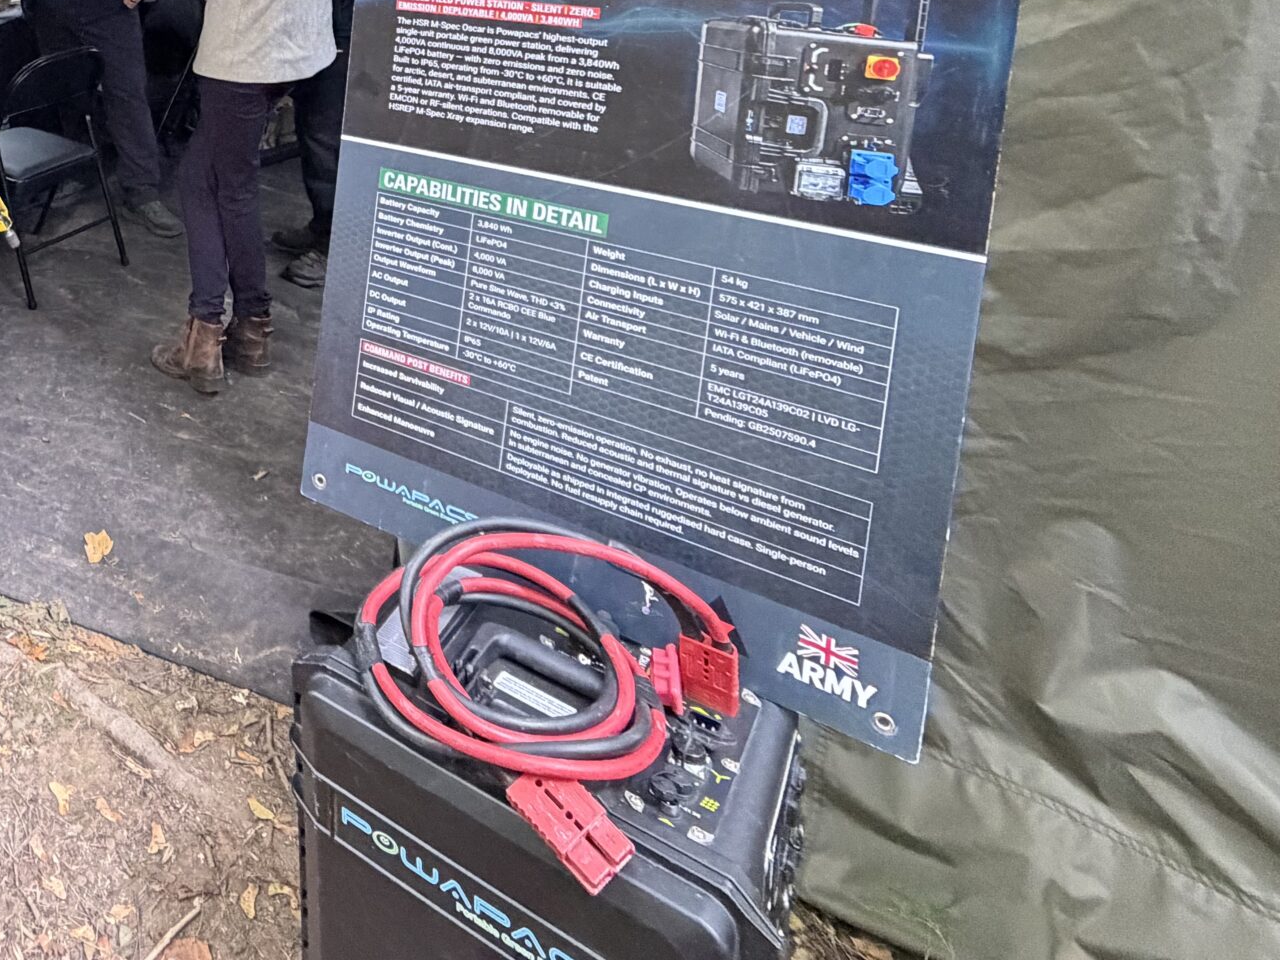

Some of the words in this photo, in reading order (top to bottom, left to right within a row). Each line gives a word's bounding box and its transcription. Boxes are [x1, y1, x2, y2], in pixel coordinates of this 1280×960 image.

[397, 0, 437, 13] EMISSION
[442, 5, 494, 18] DEPLOYABLE
[499, 10, 533, 23] 4,000VA
[539, 14, 580, 27] 3,840WH
[530, 2, 563, 14] SILENT
[568, 5, 597, 18] ZERO-
[395, 26, 435, 37] single-unit
[434, 31, 469, 41] portable
[468, 35, 493, 44] green
[493, 37, 520, 47] power
[521, 40, 553, 52] station,
[554, 43, 599, 58] delivering
[396, 15, 412, 25] The
[411, 17, 430, 27] HSR
[429, 19, 461, 31] M-Spec
[461, 22, 486, 33] Oscar
[486, 25, 494, 34] is
[541, 31, 608, 47] highest-output
[394, 35, 426, 46] 4,000VA
[426, 40, 470, 52] continuous
[470, 45, 487, 54] and
[487, 46, 523, 58] 8,000VA
[523, 51, 546, 61] peak
[546, 52, 569, 64] from
[569, 57, 577, 65] a
[577, 56, 620, 70] 3,840Wh
[390, 74, 423, 86] certified,
[424, 77, 443, 88] IATA
[442, 81, 492, 95] air-transport
[492, 89, 537, 103] compliant,
[537, 95, 556, 105] and
[556, 98, 593, 110] covered
[593, 102, 606, 114] by
[391, 63, 403, 72] for
[403, 66, 427, 77] arctic,
[427, 68, 455, 81] desert,
[455, 73, 472, 82] and
[472, 75, 527, 90] subterranean
[527, 83, 590, 99] environments.
[591, 91, 606, 101] CE
[387, 101, 415, 113] HSREP
[415, 106, 445, 118] M-Spec
[445, 110, 464, 123] Xray
[464, 115, 507, 128] expansion
[507, 122, 534, 134] range.
[388, 92, 419, 104] EMCON
[428, 98, 463, 112] RF-silent
[463, 105, 509, 119] operations.
[510, 111, 561, 127] Compatible
[561, 120, 581, 130] with
[582, 122, 598, 133] the
[383, 170, 502, 211] CAPABILITIES
[505, 196, 528, 217] IN
[531, 201, 602, 234] DETAIL
[592, 245, 626, 261] Weight
[587, 279, 631, 299] Charging
[632, 289, 664, 305] Inputs
[720, 273, 734, 284] 54
[735, 276, 748, 289] kg
[584, 309, 599, 321] Air
[600, 313, 647, 334] Transport
[586, 294, 646, 319] Connectivity
[582, 328, 625, 349] Warranty
[713, 327, 739, 341] Wi-Fi
[740, 334, 749, 344] &
[749, 336, 799, 357] Bluetooth
[799, 349, 863, 375] (removable)
[579, 350, 594, 362] CE
[594, 355, 653, 380] Certification
[709, 362, 717, 373] 5
[717, 366, 745, 380] years
[711, 343, 735, 357] IATA
[735, 349, 788, 371] Compliant
[577, 369, 609, 387] Patent
[703, 406, 746, 428] Pending:
[507, 437, 517, 447] in
[516, 442, 569, 466] subterranean
[569, 461, 587, 473] and
[586, 467, 632, 489] concealed
[632, 482, 647, 492] CP
[647, 488, 712, 517] environments.
[510, 415, 559, 438] combustion.
[560, 431, 598, 451] Reduced
[597, 445, 635, 464] acoustic
[635, 458, 654, 470] and
[654, 463, 691, 482] thermal
[691, 477, 736, 498] signature
[737, 492, 749, 503] vs
[750, 496, 781, 513] diesel
[782, 508, 835, 532] generator.
[775, 651, 878, 709] ARMY
[455, 901, 500, 939] Portable
